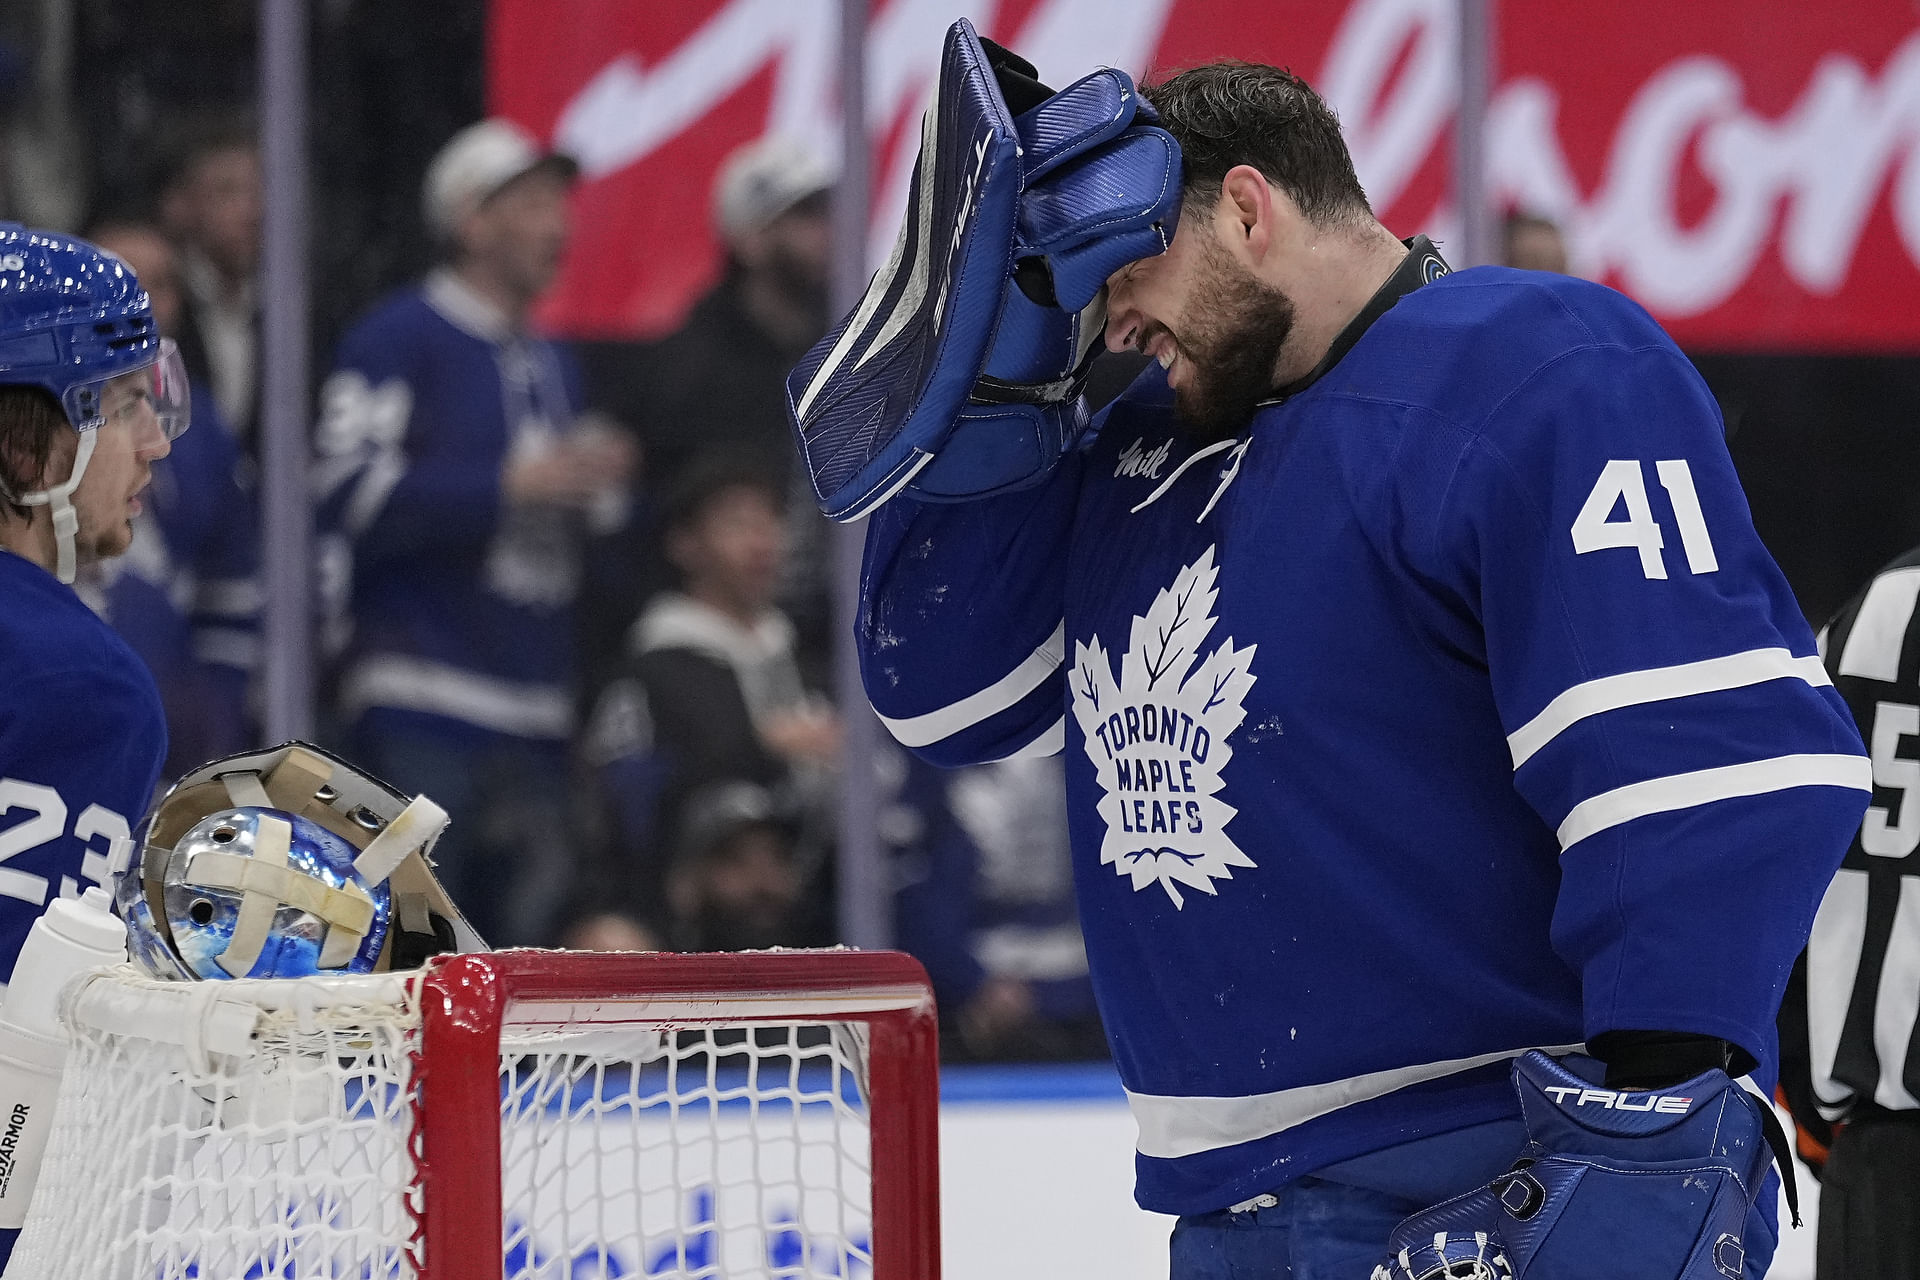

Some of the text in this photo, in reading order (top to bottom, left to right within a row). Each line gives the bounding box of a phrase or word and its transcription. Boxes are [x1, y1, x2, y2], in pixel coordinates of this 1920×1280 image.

[550, 0, 1920, 316] Mlson
[1113, 436, 1175, 480] Milk
[1570, 459, 1720, 580] 41
[1095, 703, 1211, 765] TORONTO
[1115, 758, 1196, 793] MAPLE
[0, 776, 131, 907] 23
[1120, 799, 1203, 834] LEAFS
[1544, 1086, 1693, 1114] TRUE
